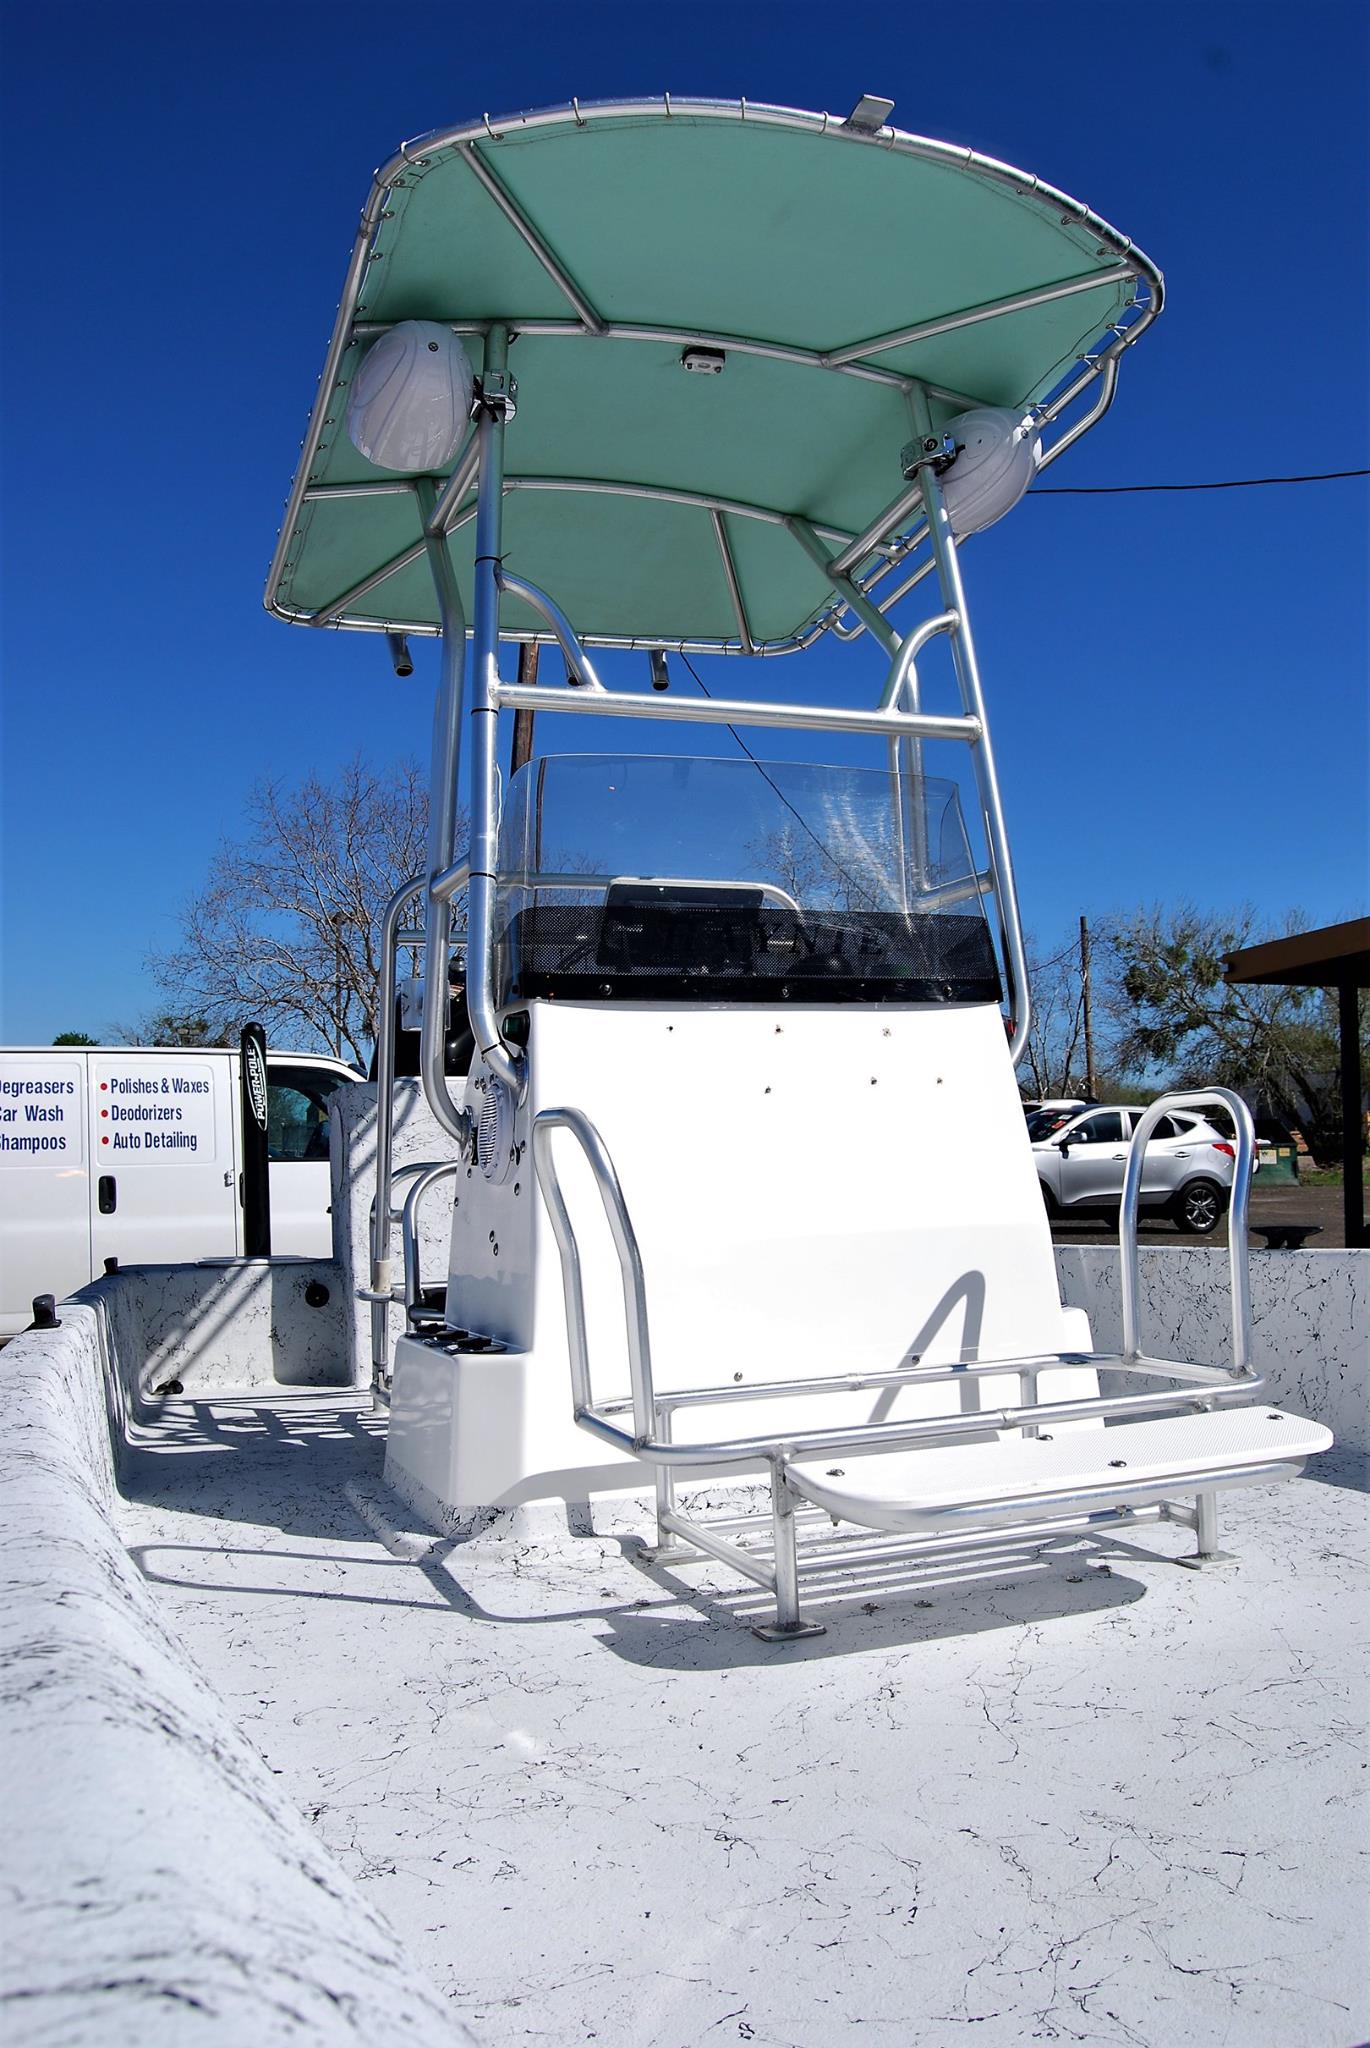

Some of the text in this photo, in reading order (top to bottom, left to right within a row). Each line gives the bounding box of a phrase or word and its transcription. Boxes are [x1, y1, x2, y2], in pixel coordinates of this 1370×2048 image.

[110, 1077, 210, 1094] Polishes & Waxes
[24, 1105, 64, 1122] Wash
[111, 1104, 182, 1121] Deodorizers
[113, 1132, 197, 1152] Auto Detailing
